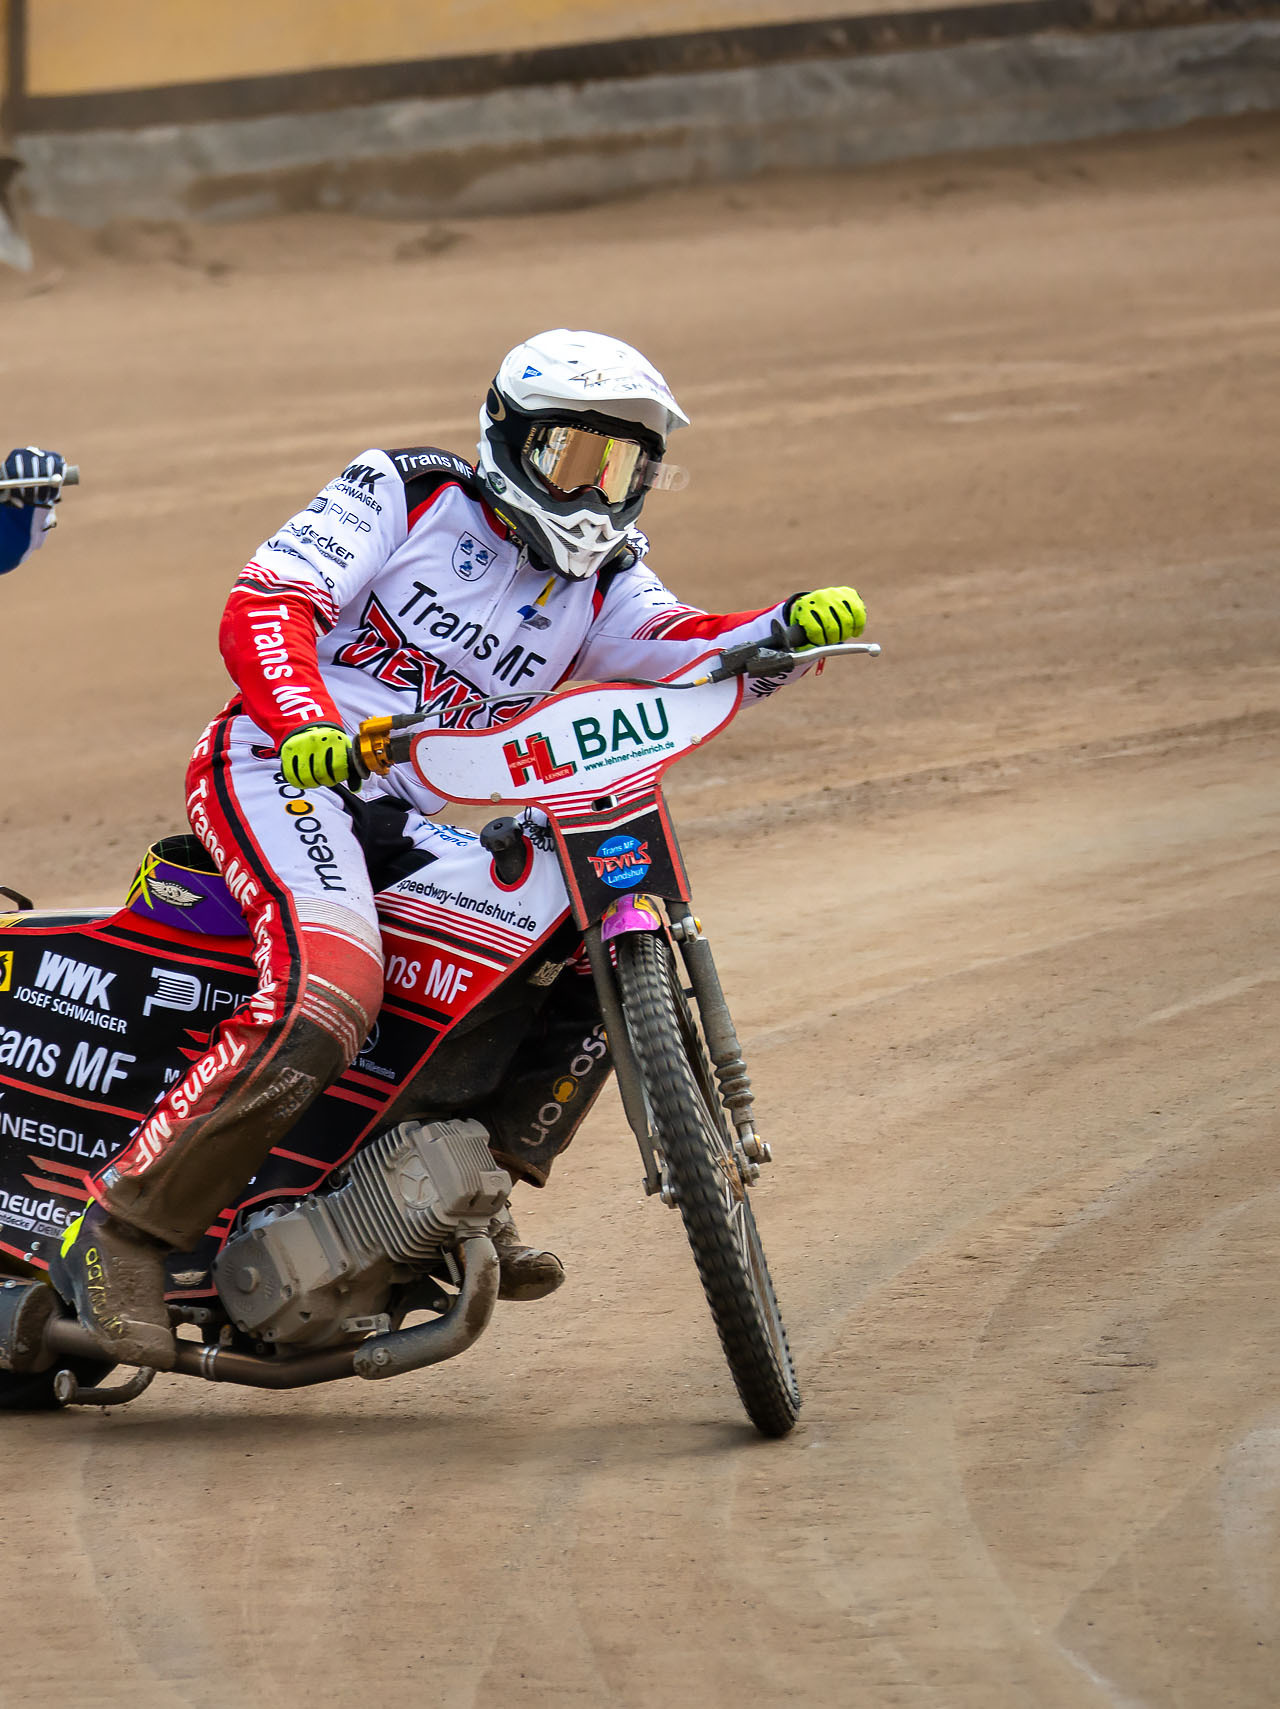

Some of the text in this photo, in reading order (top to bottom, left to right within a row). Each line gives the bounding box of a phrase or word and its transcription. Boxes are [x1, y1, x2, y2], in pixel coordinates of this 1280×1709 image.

[394, 453, 474, 479] Trans MF
[398, 581, 501, 661] Trans
[247, 604, 294, 681] Trans
[271, 685, 325, 721] MF
[571, 697, 670, 761] BAU
[544, 768, 570, 782] LEHNER
[583, 741, 676, 772] www.lehner-heinrich.de
[587, 841, 652, 879] DEVILS
[600, 841, 635, 857] Trans MF
[226, 857, 259, 906] MF
[607, 868, 645, 885] Landshut
[397, 878, 537, 932] speedway-landshut.de
[33, 950, 118, 1011] WWK
[424, 958, 474, 1005] MF
[13, 986, 128, 1035] JOSEF SCHWAIGER
[65, 1041, 137, 1095] MF
[135, 1030, 247, 1174] Trans MF
